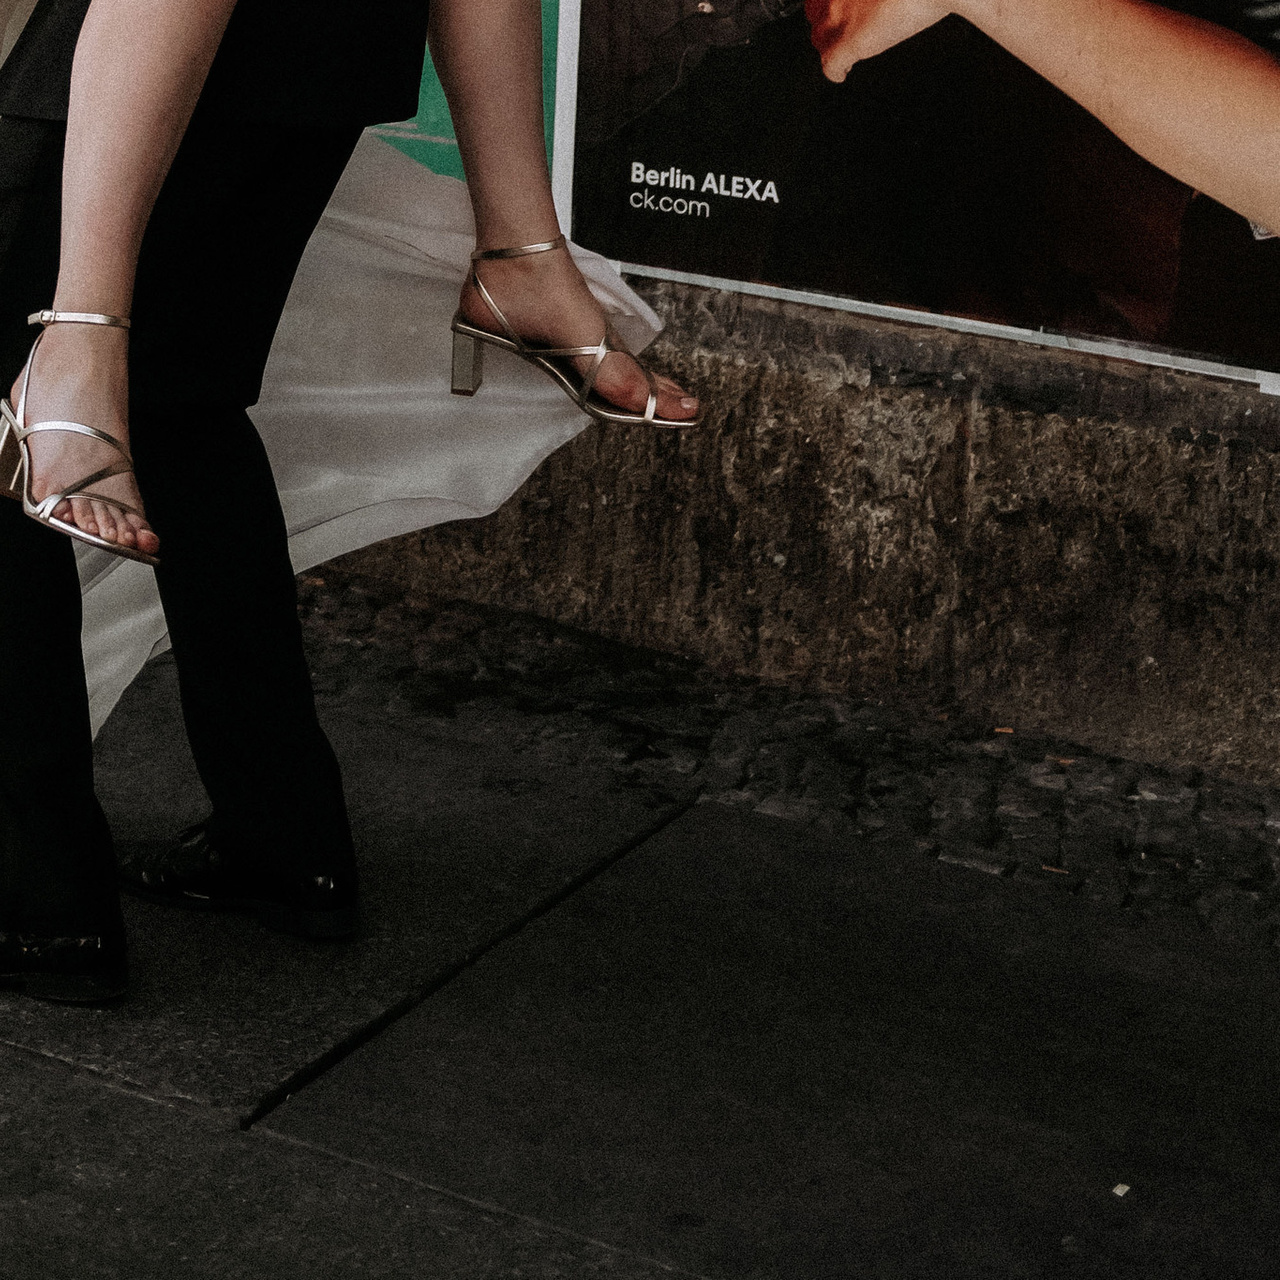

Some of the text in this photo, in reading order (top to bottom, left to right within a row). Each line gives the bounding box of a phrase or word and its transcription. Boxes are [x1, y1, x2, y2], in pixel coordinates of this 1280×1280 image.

[630, 161, 780, 204] Berlin ALEXA
[629, 188, 711, 219] ck.com
